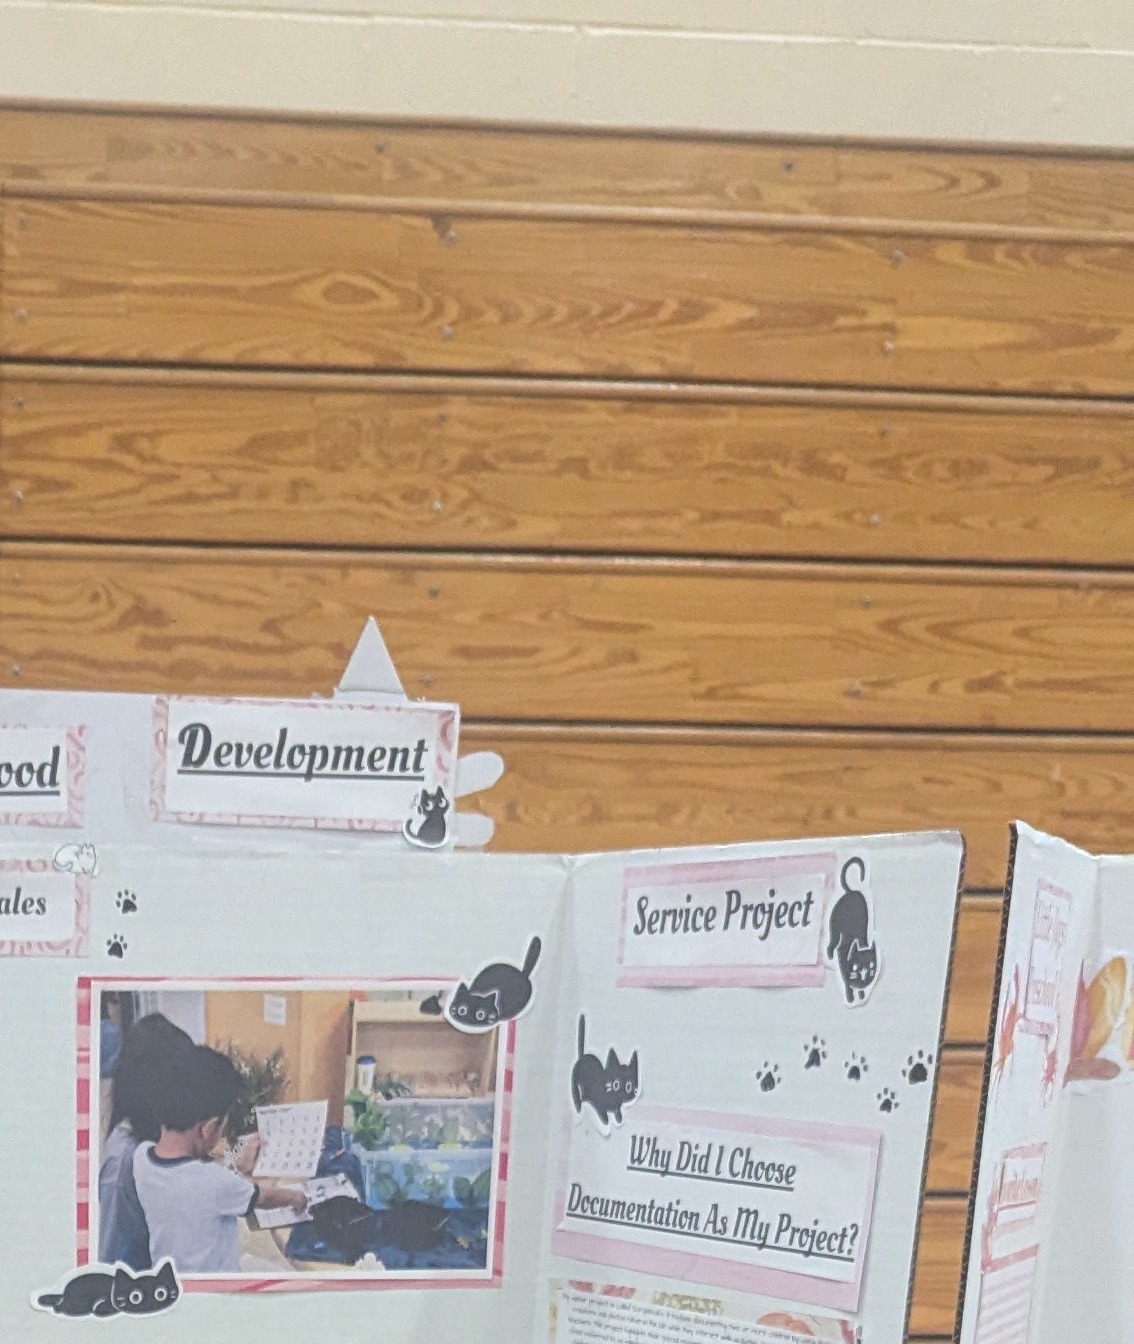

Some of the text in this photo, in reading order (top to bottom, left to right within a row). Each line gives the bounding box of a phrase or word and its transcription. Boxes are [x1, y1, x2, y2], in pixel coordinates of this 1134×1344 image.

[178, 722, 429, 783] Development
[634, 889, 814, 941] Service Project
[628, 1135, 797, 1186] Why Did I Choose
[568, 1183, 859, 1262] Documentation As My Project?
